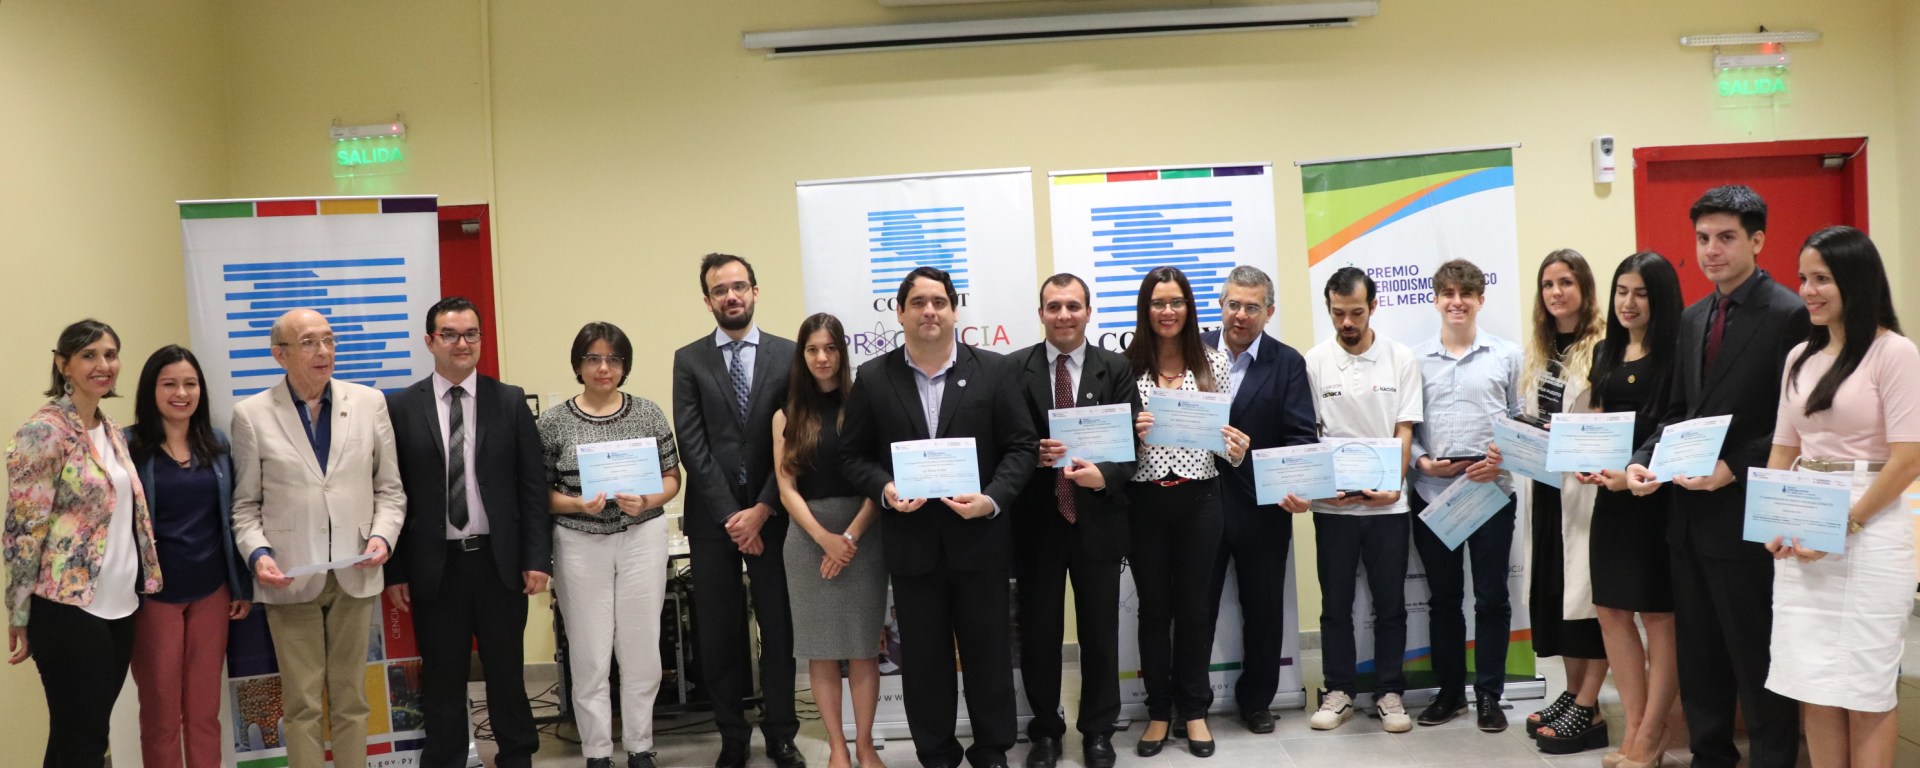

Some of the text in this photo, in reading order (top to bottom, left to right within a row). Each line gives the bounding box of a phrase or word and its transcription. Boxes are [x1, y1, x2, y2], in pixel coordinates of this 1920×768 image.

[1719, 77, 1786, 97] SALIDA
[337, 146, 405, 165] SALIDA
[1367, 264, 1419, 279] PREMIO
[1374, 276, 1434, 293] ERIODISMO
[1379, 295, 1394, 307] EL
